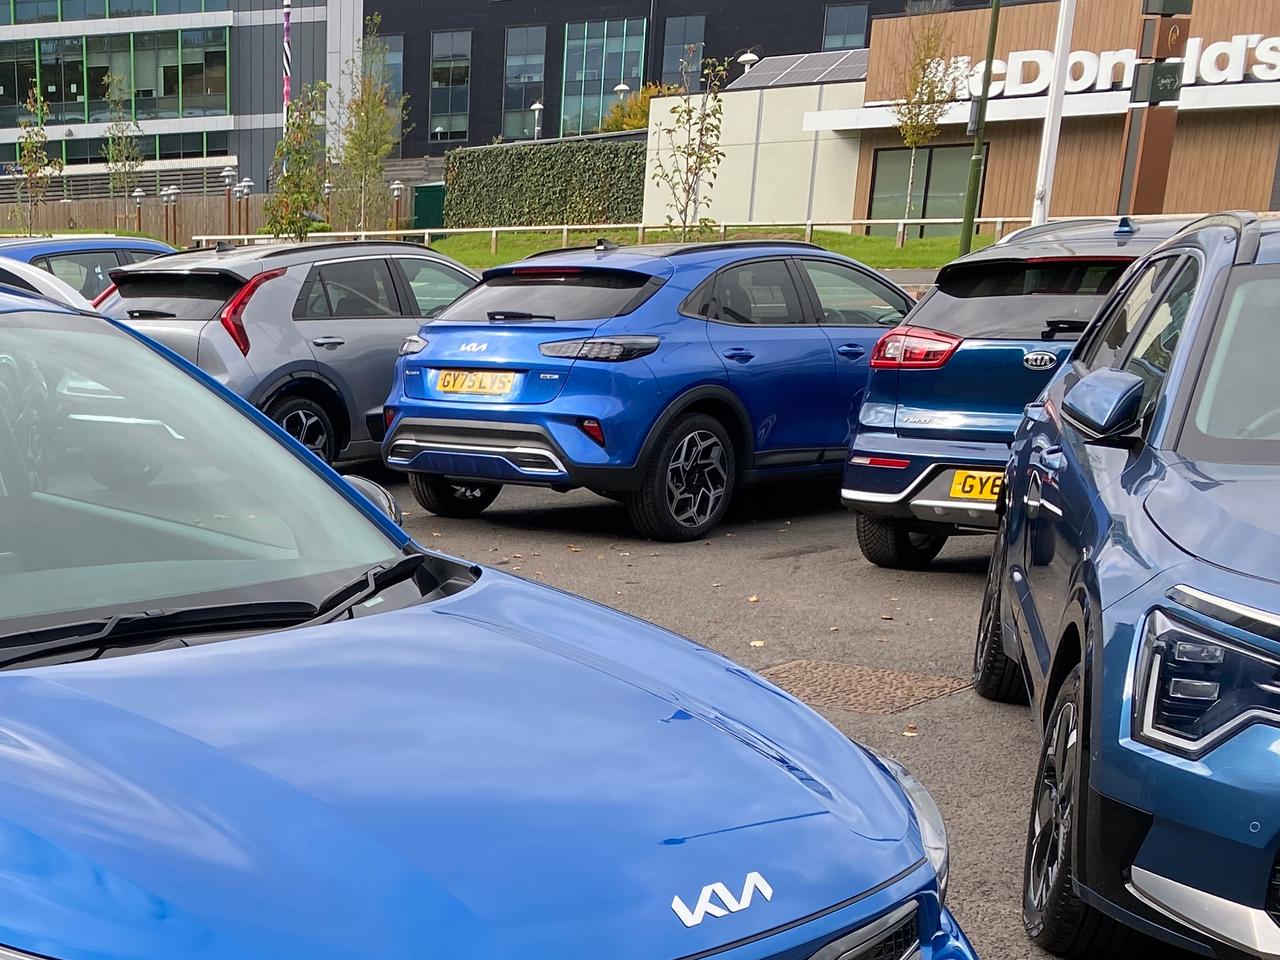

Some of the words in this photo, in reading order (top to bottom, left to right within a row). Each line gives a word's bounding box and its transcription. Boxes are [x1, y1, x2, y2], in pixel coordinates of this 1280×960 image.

[916, 33, 1280, 101] McDonld's
[442, 372, 476, 389] GY75
[479, 373, 507, 391] LVS
[671, 871, 773, 928] KIA
